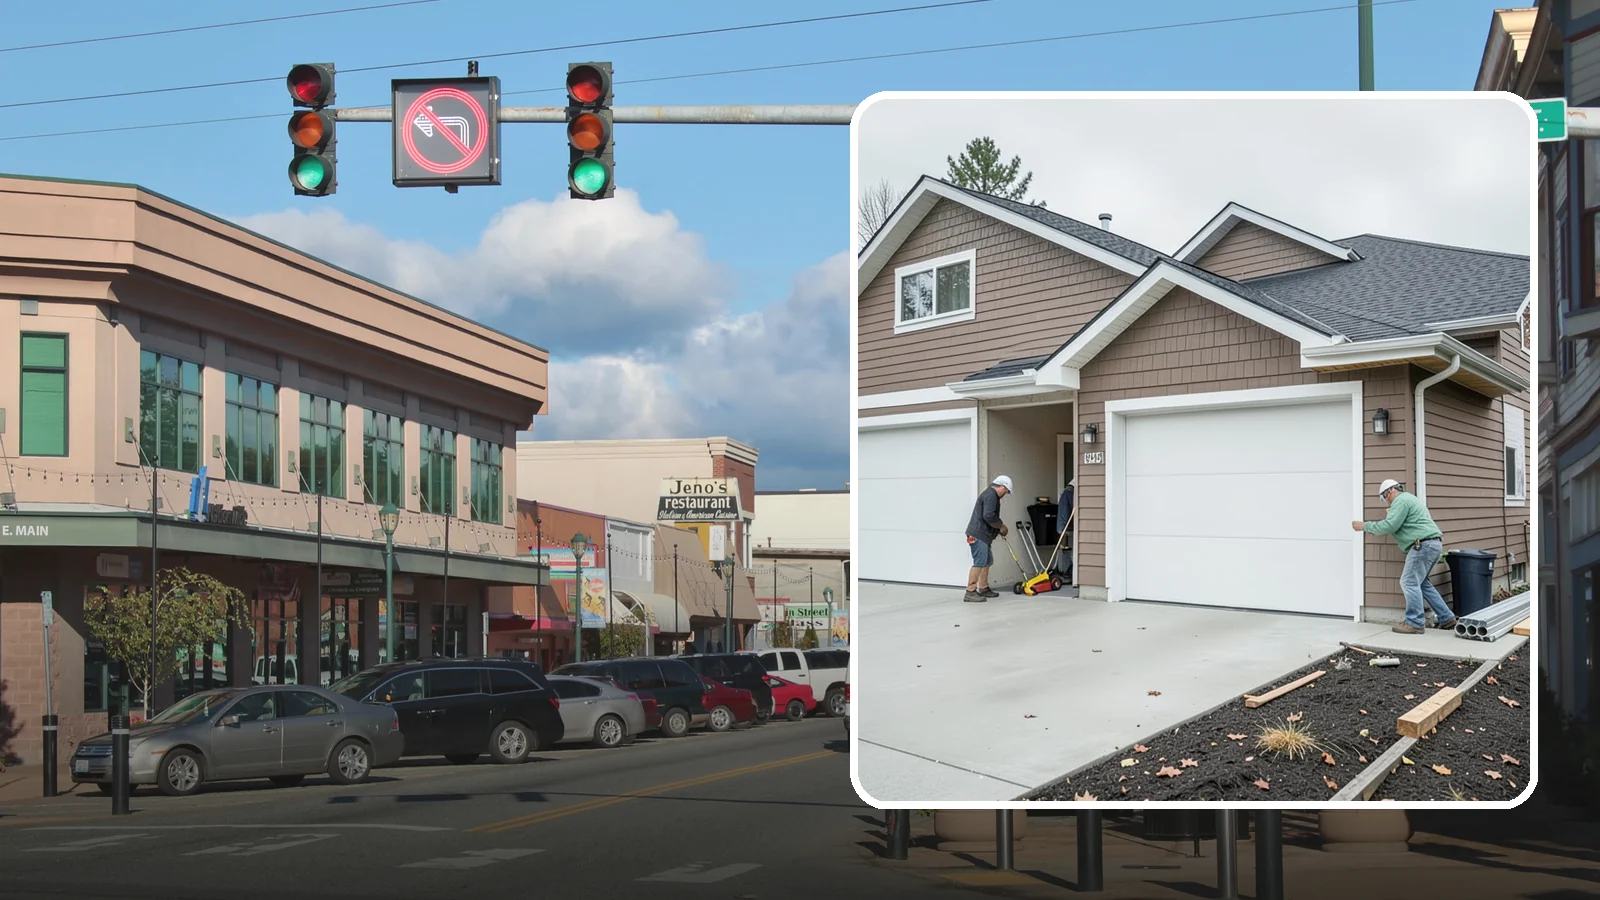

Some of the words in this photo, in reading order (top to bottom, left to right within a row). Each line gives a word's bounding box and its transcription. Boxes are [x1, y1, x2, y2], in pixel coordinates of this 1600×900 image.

[670, 480, 728, 494] Jeno's
[665, 496, 731, 509] restaurant
[686, 510, 715, 519] American
[715, 510, 737, 519] Cuisine
[2, 525, 12, 536] E.
[16, 525, 48, 536] MAIN
[798, 608, 828, 617] Street
